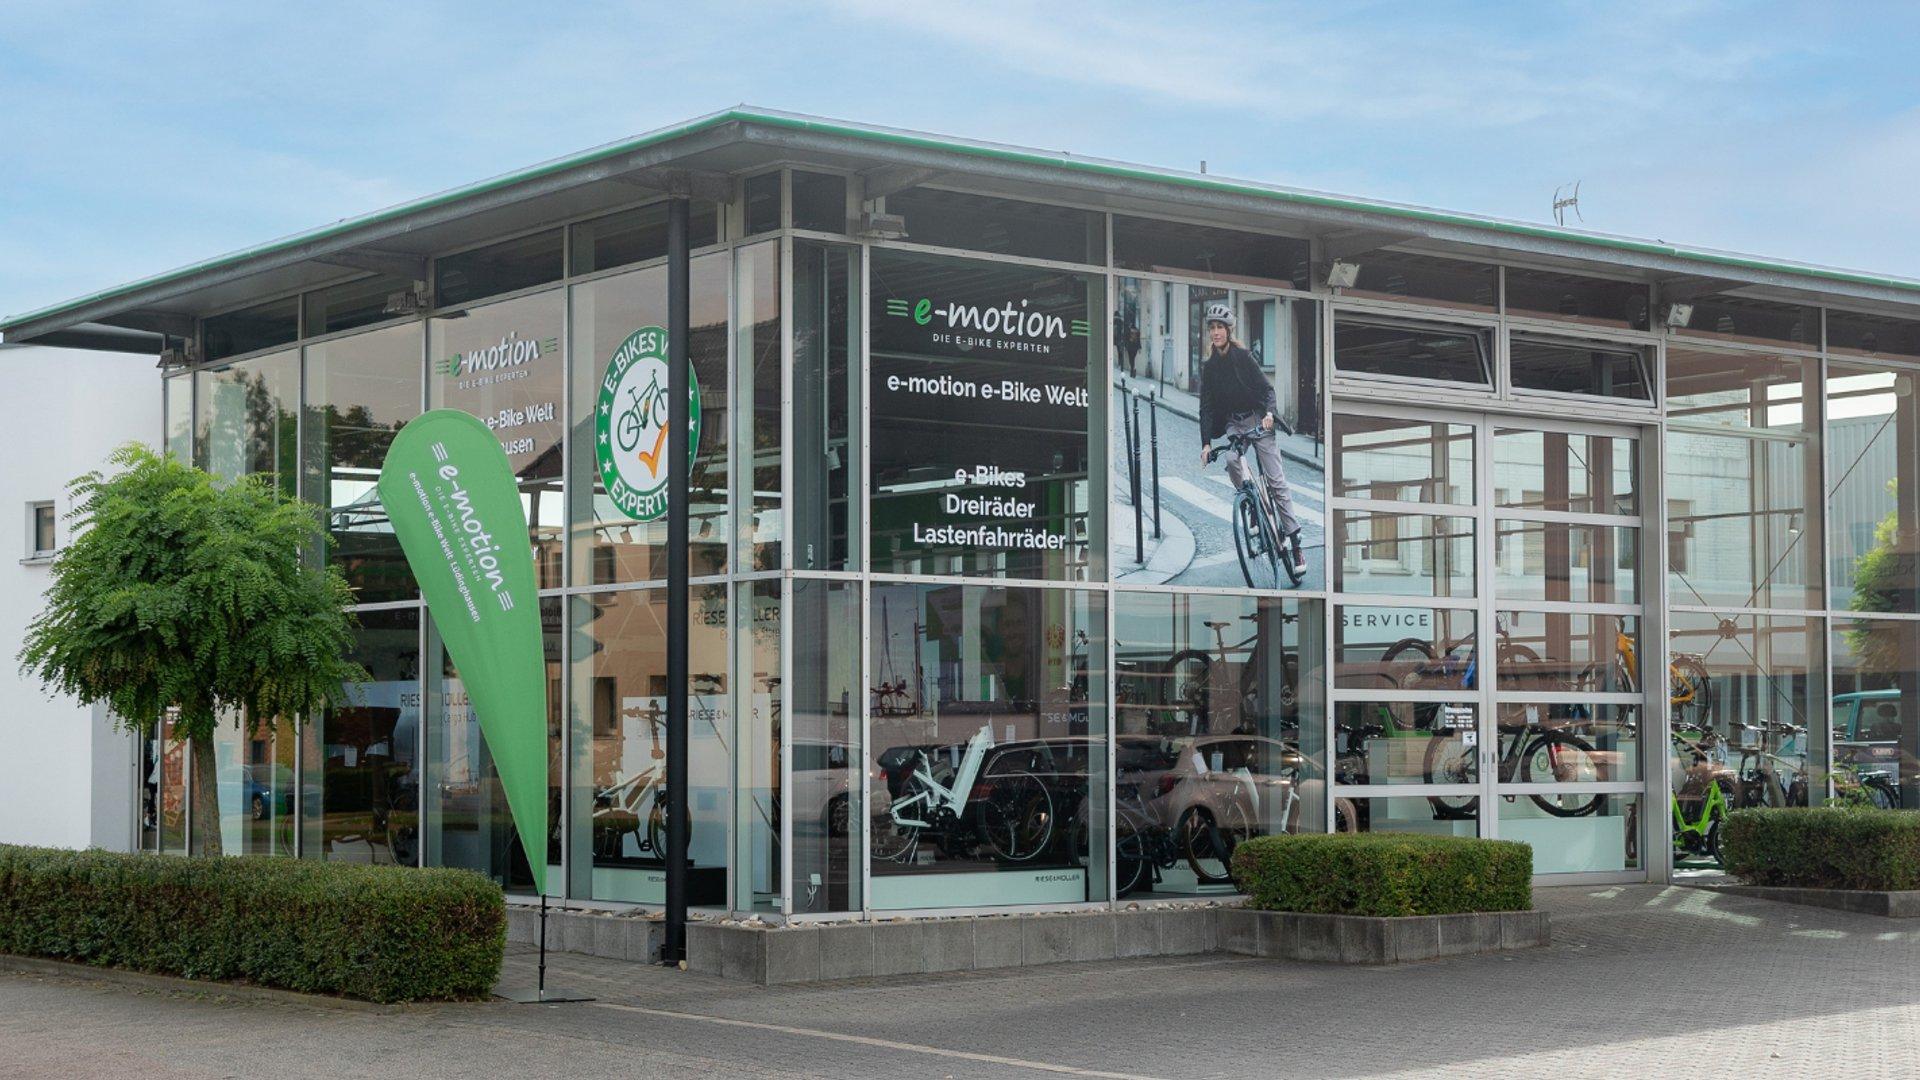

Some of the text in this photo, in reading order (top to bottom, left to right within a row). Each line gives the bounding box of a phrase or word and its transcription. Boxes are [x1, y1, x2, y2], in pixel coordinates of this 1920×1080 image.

[914, 298, 1067, 339] e-motion
[450, 331, 541, 377] e-motion
[932, 333, 1051, 354] DIE E-BIKE EXPERTEN
[604, 332, 657, 395] E-BIKES
[887, 374, 1090, 408] e-motion e-Bike Welt
[487, 408, 524, 430] e-Bike
[525, 402, 554, 423] Welt
[954, 465, 1026, 488] e-Bikes
[945, 493, 1036, 518] Dreiräder
[438, 464, 504, 592] e-motion
[913, 522, 1067, 549] Lastenfahrräder
[409, 472, 481, 623] e-motion e-Bike Welt Lüdinghausen
[1343, 614, 1428, 627] SERVICE
